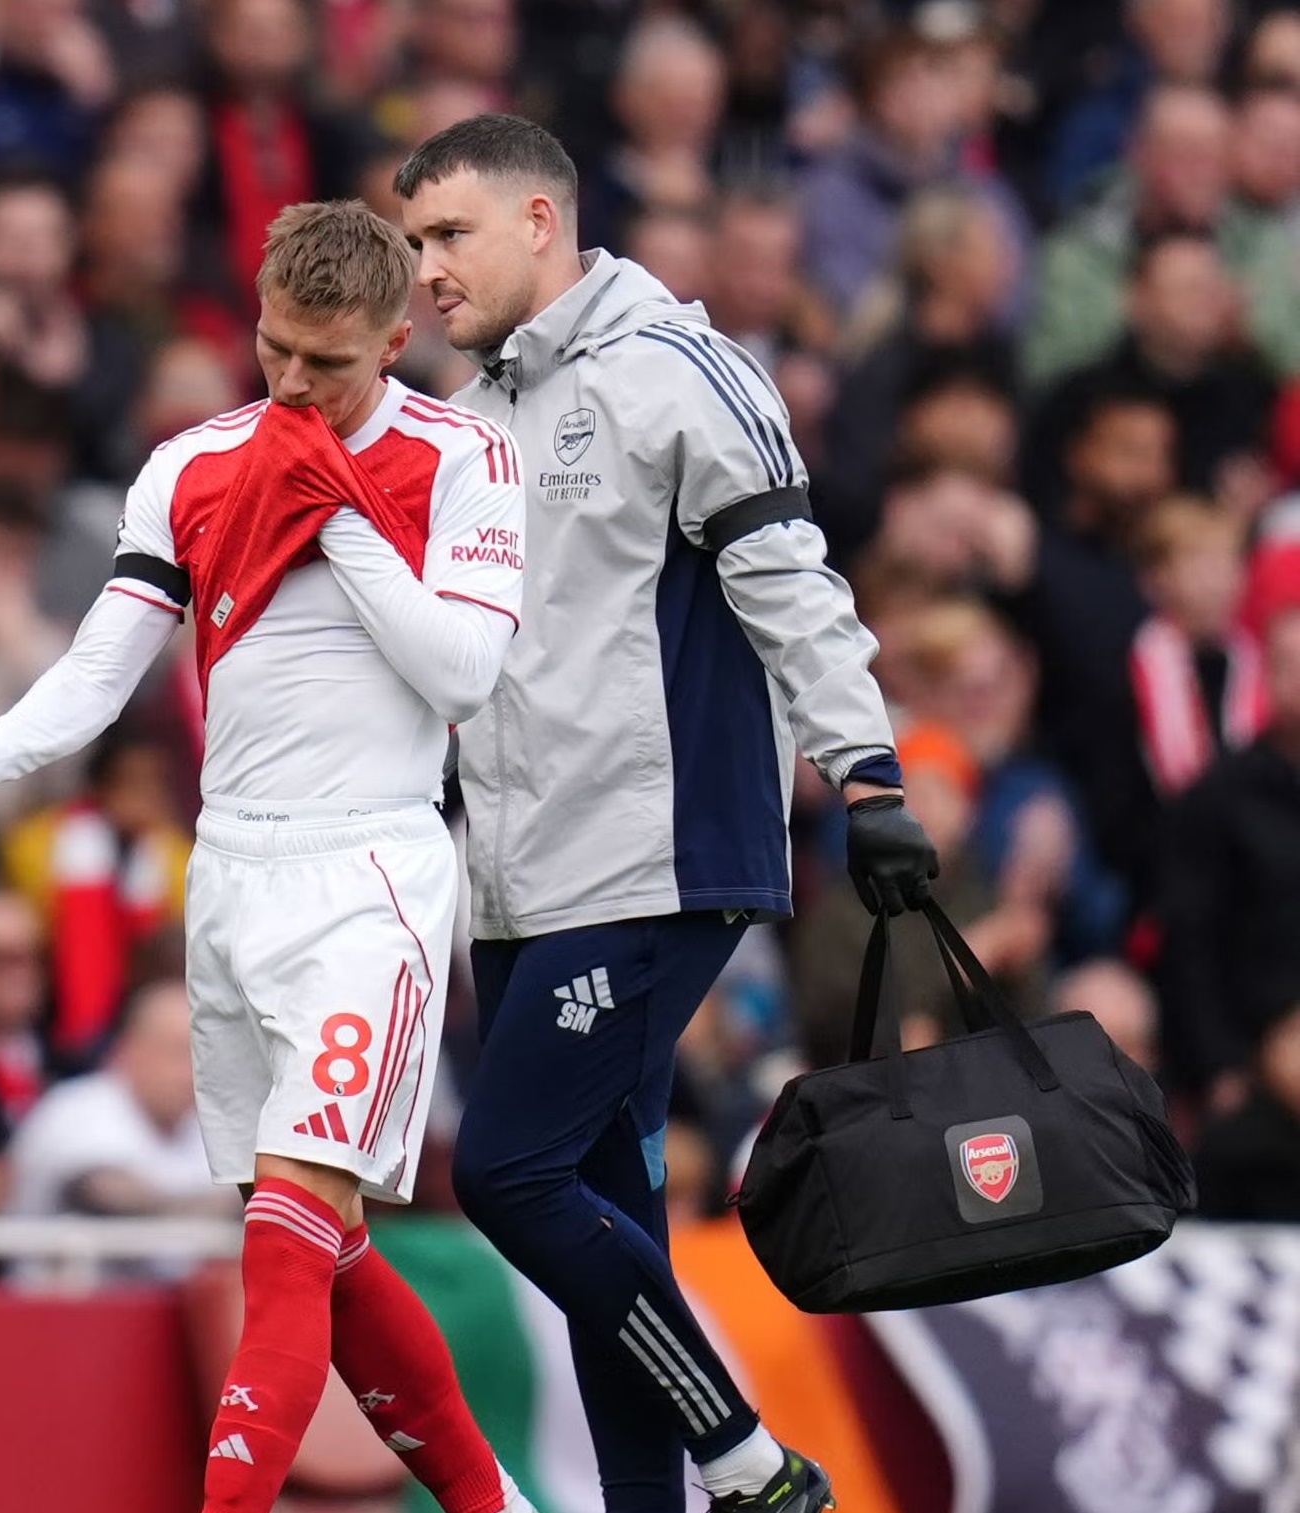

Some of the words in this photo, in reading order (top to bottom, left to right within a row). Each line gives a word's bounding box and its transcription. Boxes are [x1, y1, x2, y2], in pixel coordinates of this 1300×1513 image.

[540, 470, 601, 487] Emirates
[560, 487, 590, 500] BETTER
[476, 527, 518, 549] VISIT
[237, 809, 264, 821] Calvin
[266, 812, 290, 822] Klein
[556, 1001, 598, 1034] SM
[312, 1012, 372, 1096] 8
[968, 1142, 1009, 1160] Arsenal
